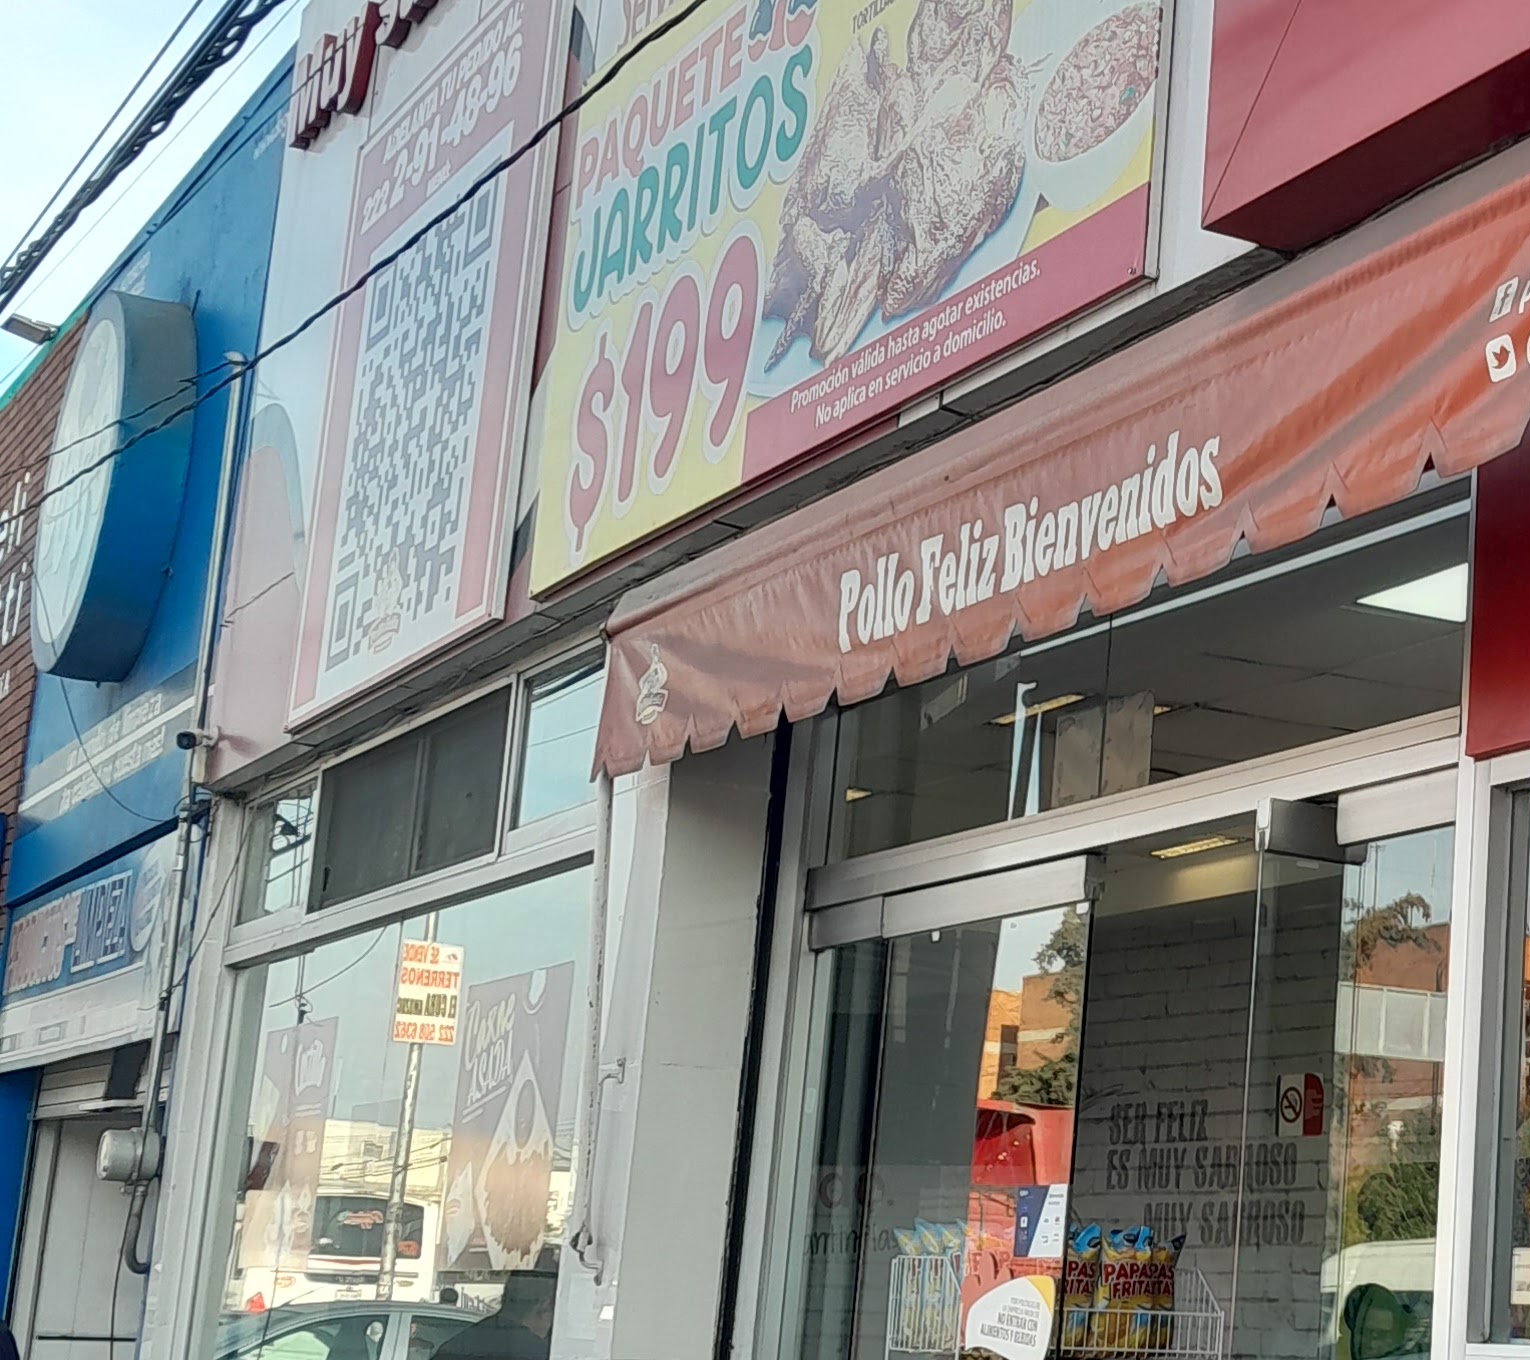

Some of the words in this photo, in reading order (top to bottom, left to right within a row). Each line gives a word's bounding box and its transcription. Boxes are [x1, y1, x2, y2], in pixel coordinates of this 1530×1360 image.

[573, 43, 813, 313] JARRITOS
[580, 11, 744, 190] PAQUETE
[571, 236, 757, 554] $199
[790, 364, 849, 413] Promoción
[851, 344, 885, 381] válida
[887, 326, 919, 358] hasta
[922, 301, 962, 341] agotar
[965, 259, 1041, 314] existencias.
[815, 404, 831, 428] No
[833, 384, 866, 421] aplica
[868, 378, 883, 399] en
[885, 349, 931, 390] servicio
[933, 345, 941, 365] a
[943, 307, 1006, 358] domicilio.
[838, 555, 914, 654] Pollo
[916, 522, 999, 624] Feliz
[1000, 429, 1223, 594] Bienvenidos
[1106, 1149, 1131, 1191] ES
